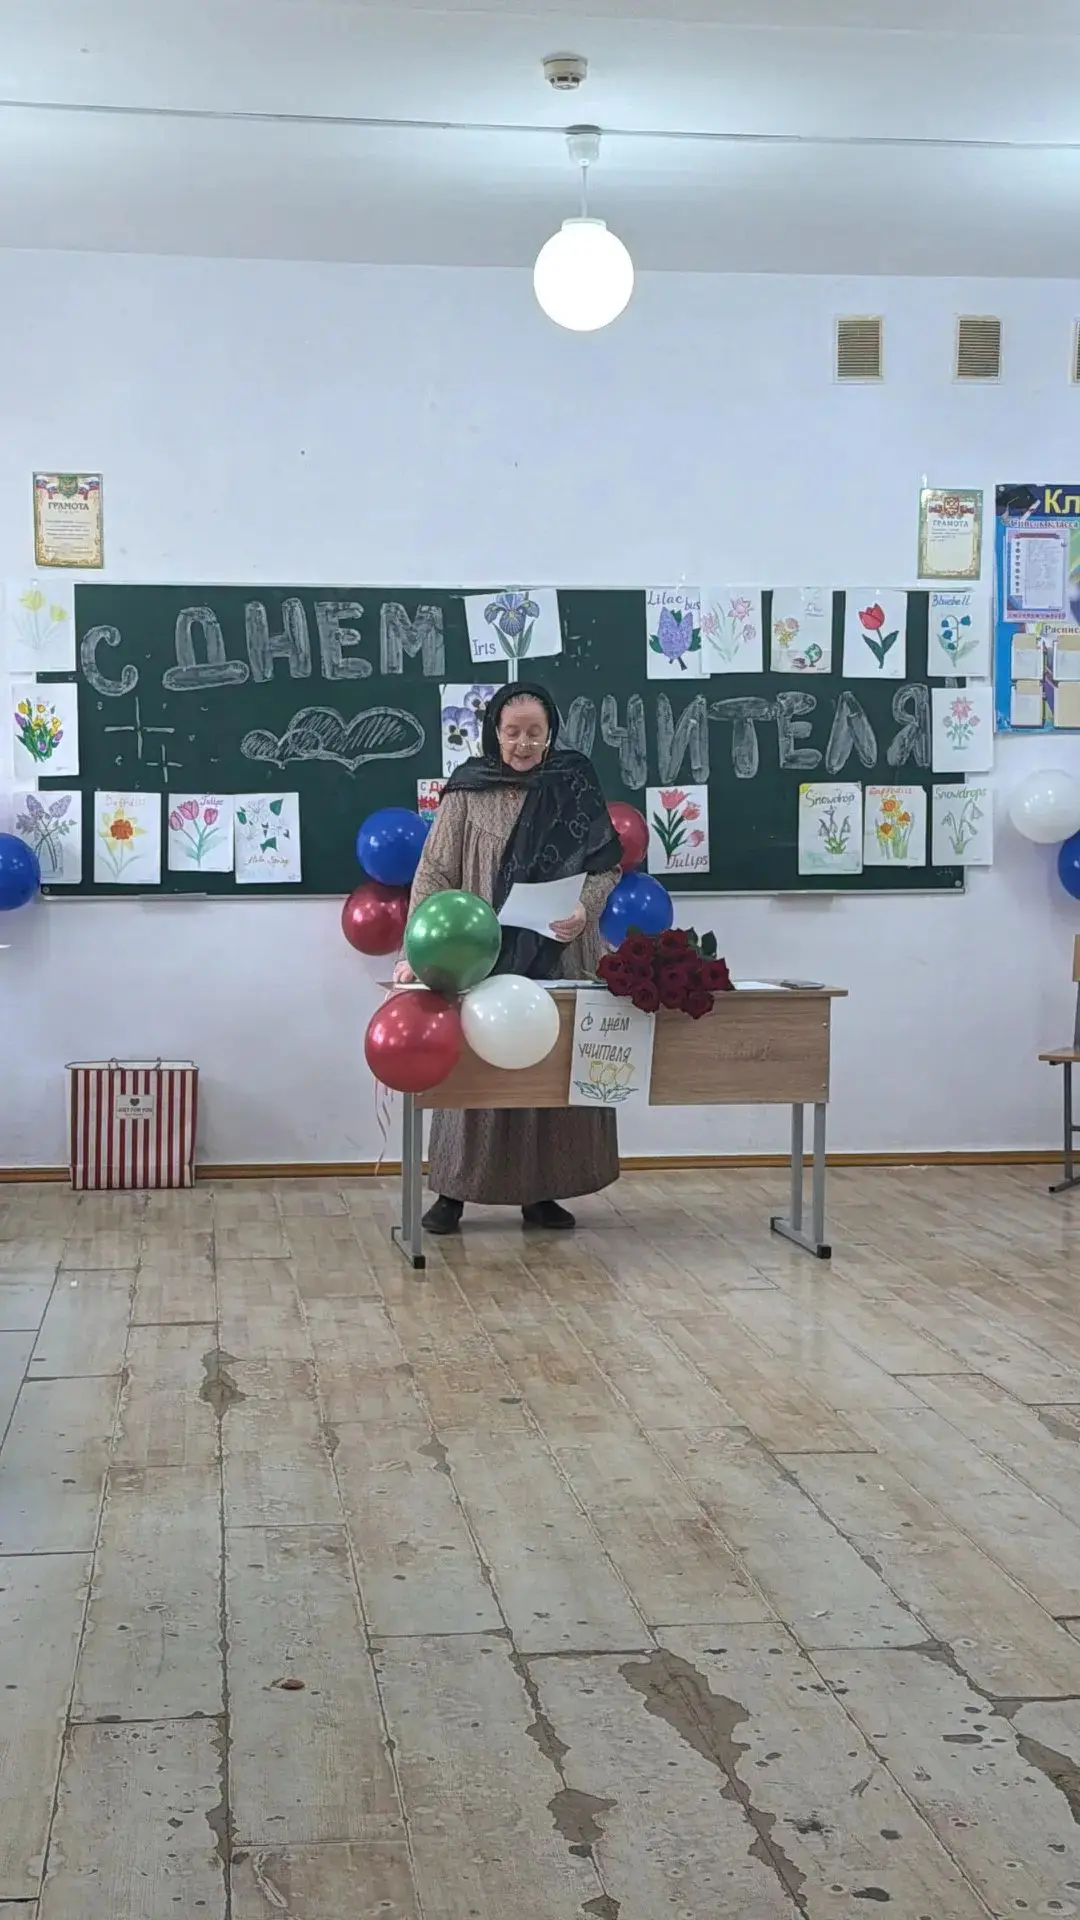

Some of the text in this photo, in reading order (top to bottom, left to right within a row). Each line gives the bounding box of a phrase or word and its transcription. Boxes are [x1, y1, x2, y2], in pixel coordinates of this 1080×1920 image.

[48, 502, 89, 510] ГРАМОТА
[1044, 488, 1080, 514] Кл
[932, 520, 969, 528] ГРАМОТА
[647, 590, 684, 606] Lilac
[80, 596, 446, 697] С ДНЕМ
[472, 639, 497, 656] Iris
